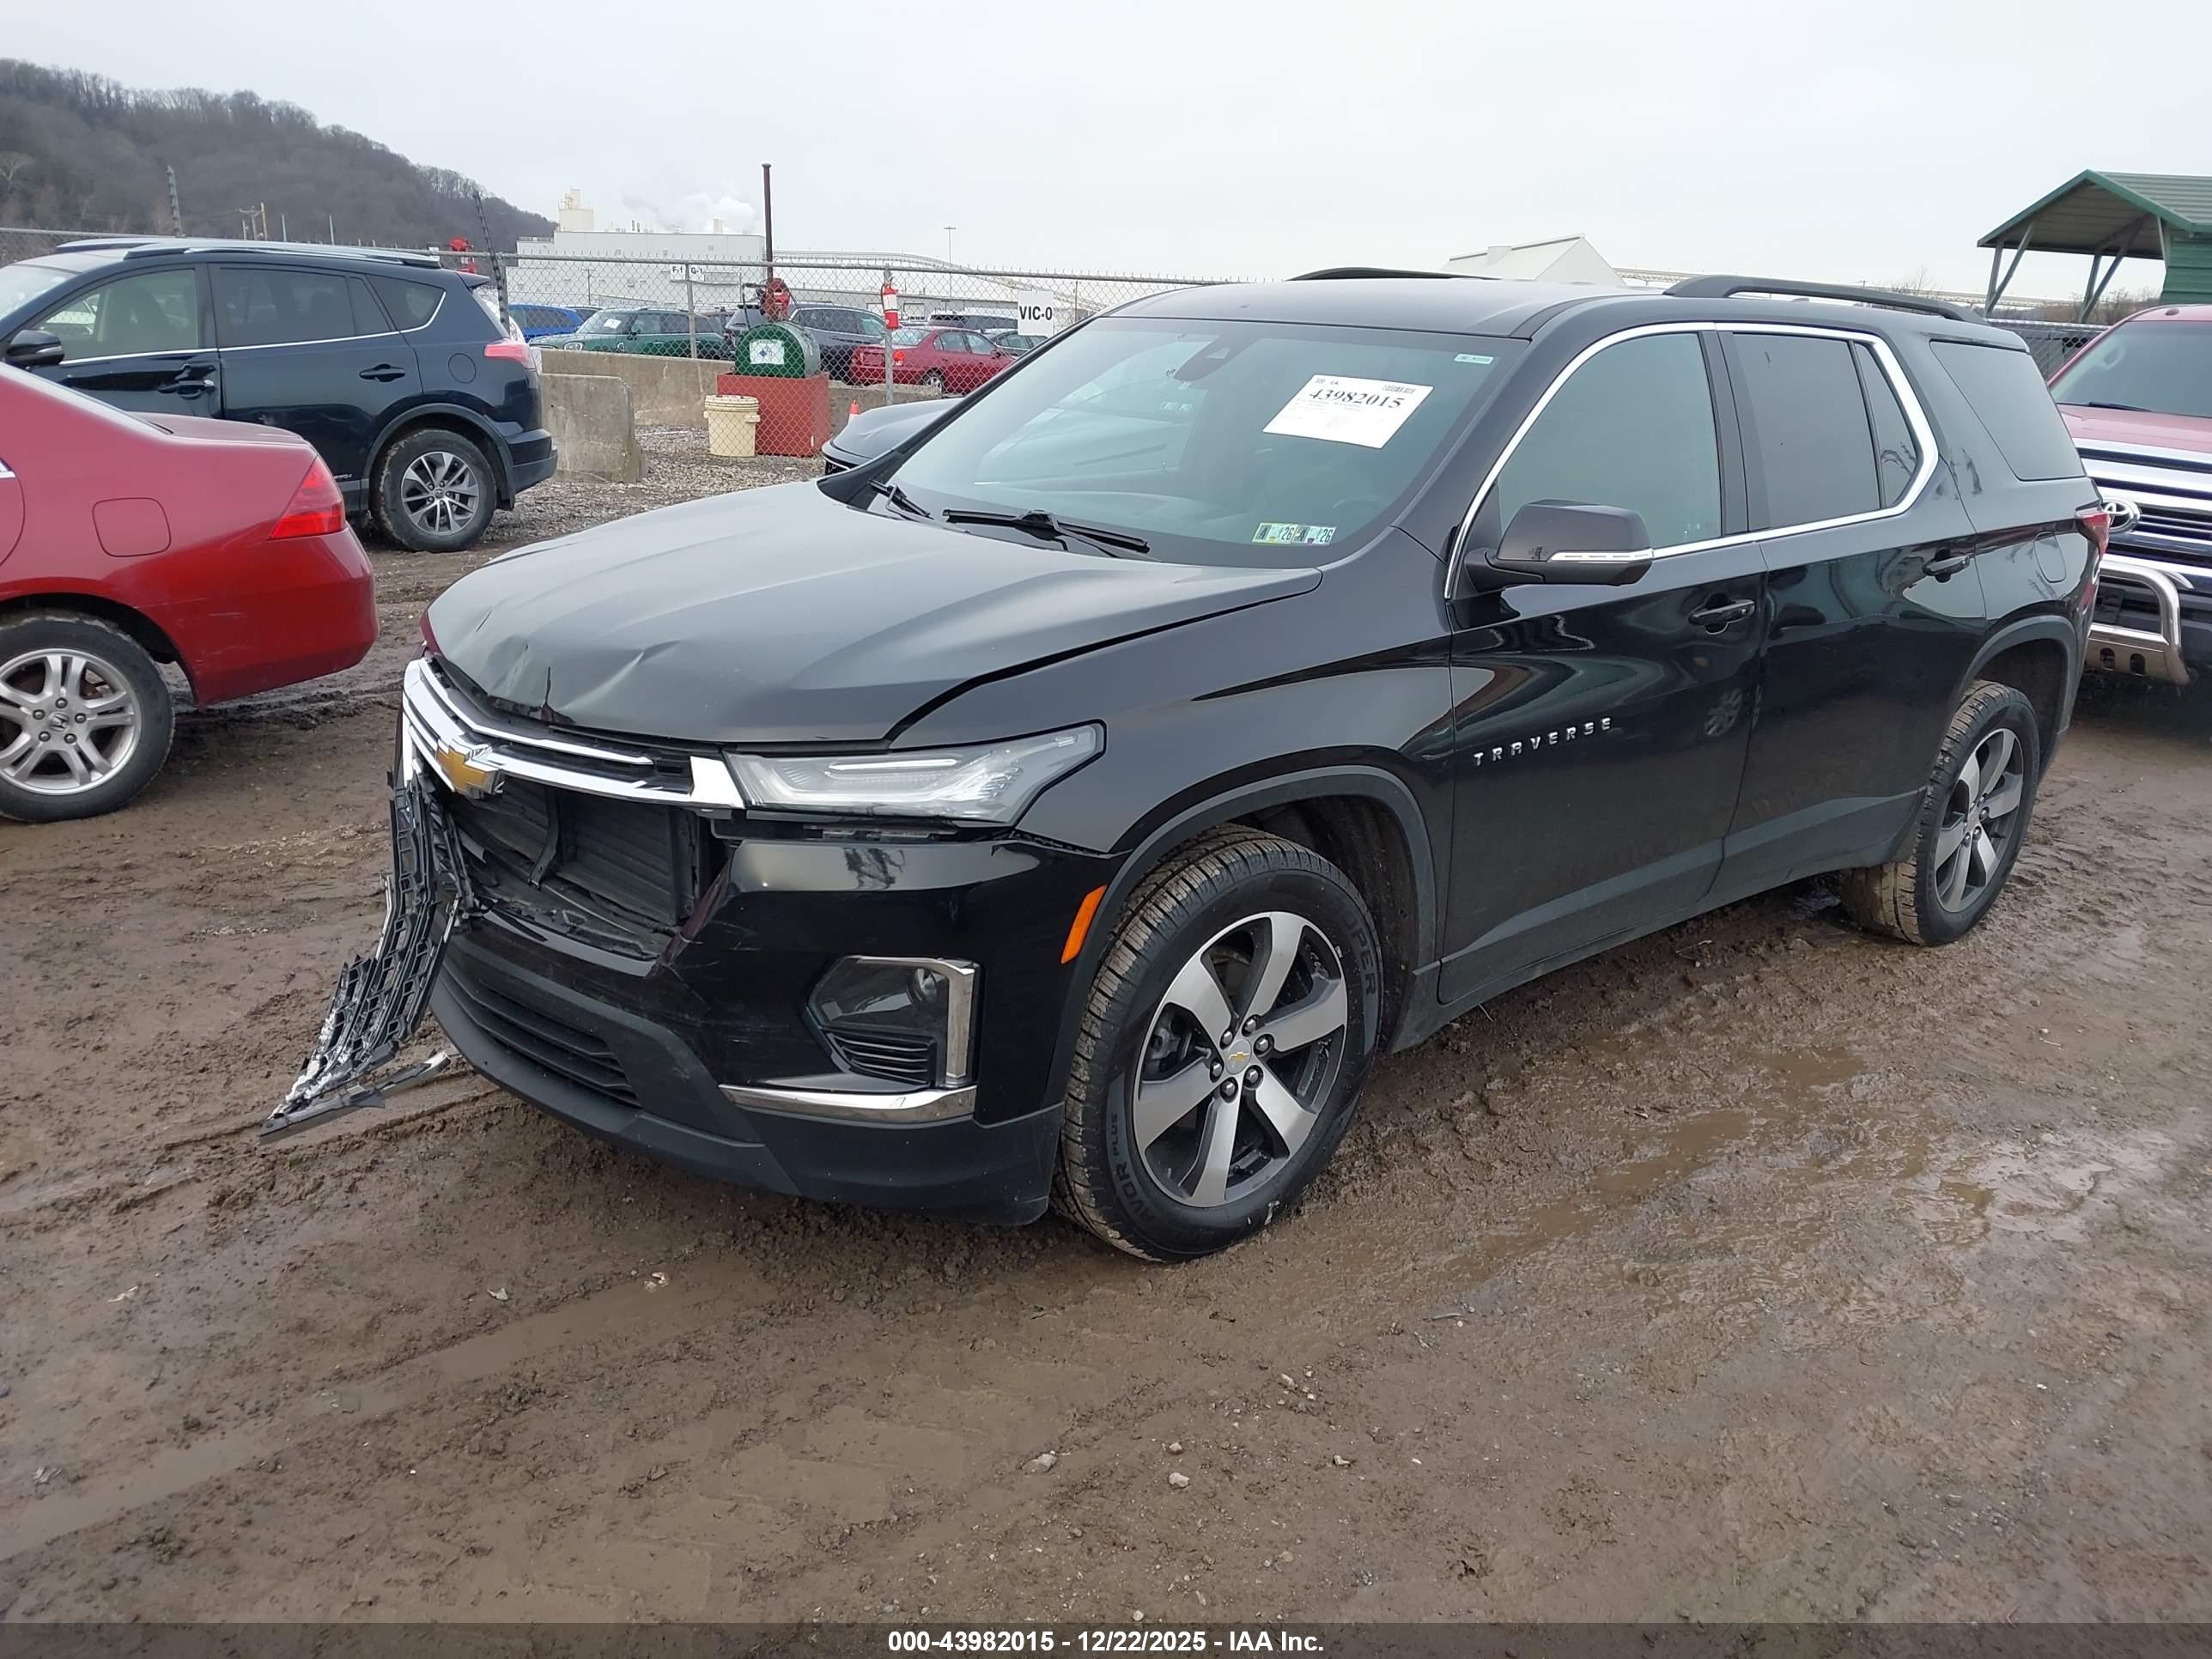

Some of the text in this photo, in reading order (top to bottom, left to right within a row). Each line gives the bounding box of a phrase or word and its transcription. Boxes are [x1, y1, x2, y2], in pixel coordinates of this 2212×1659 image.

[672, 265, 683, 274] F-1
[690, 266, 702, 275] G-1
[1309, 388, 1406, 410] 43982015
[1280, 527, 1295, 541] 26
[1319, 528, 1334, 543] 26
[1473, 717, 1612, 767] TRAVERSE
[1110, 1113, 1120, 1157] PLUS
